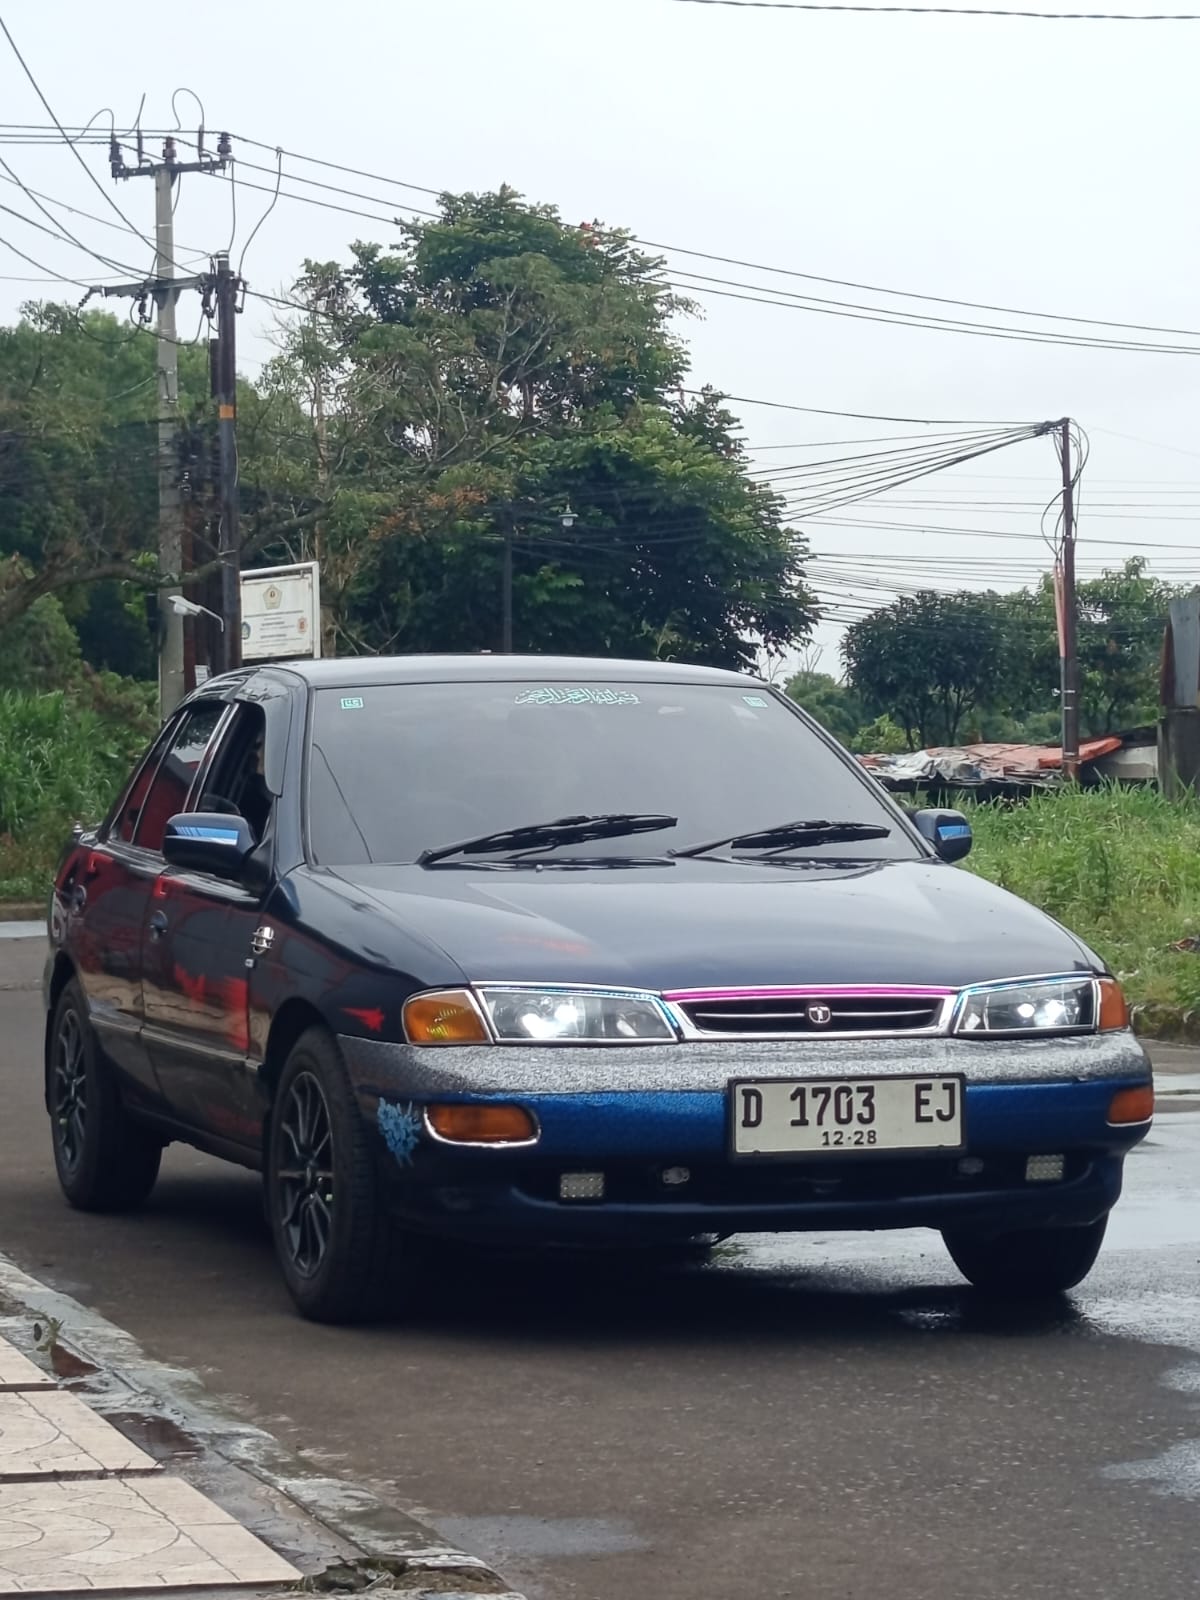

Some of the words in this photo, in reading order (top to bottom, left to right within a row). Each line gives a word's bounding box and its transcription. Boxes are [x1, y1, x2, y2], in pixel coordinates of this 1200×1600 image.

[741, 1088, 763, 1128] D
[789, 1085, 875, 1127] 1703
[914, 1082, 956, 1123] EJ
